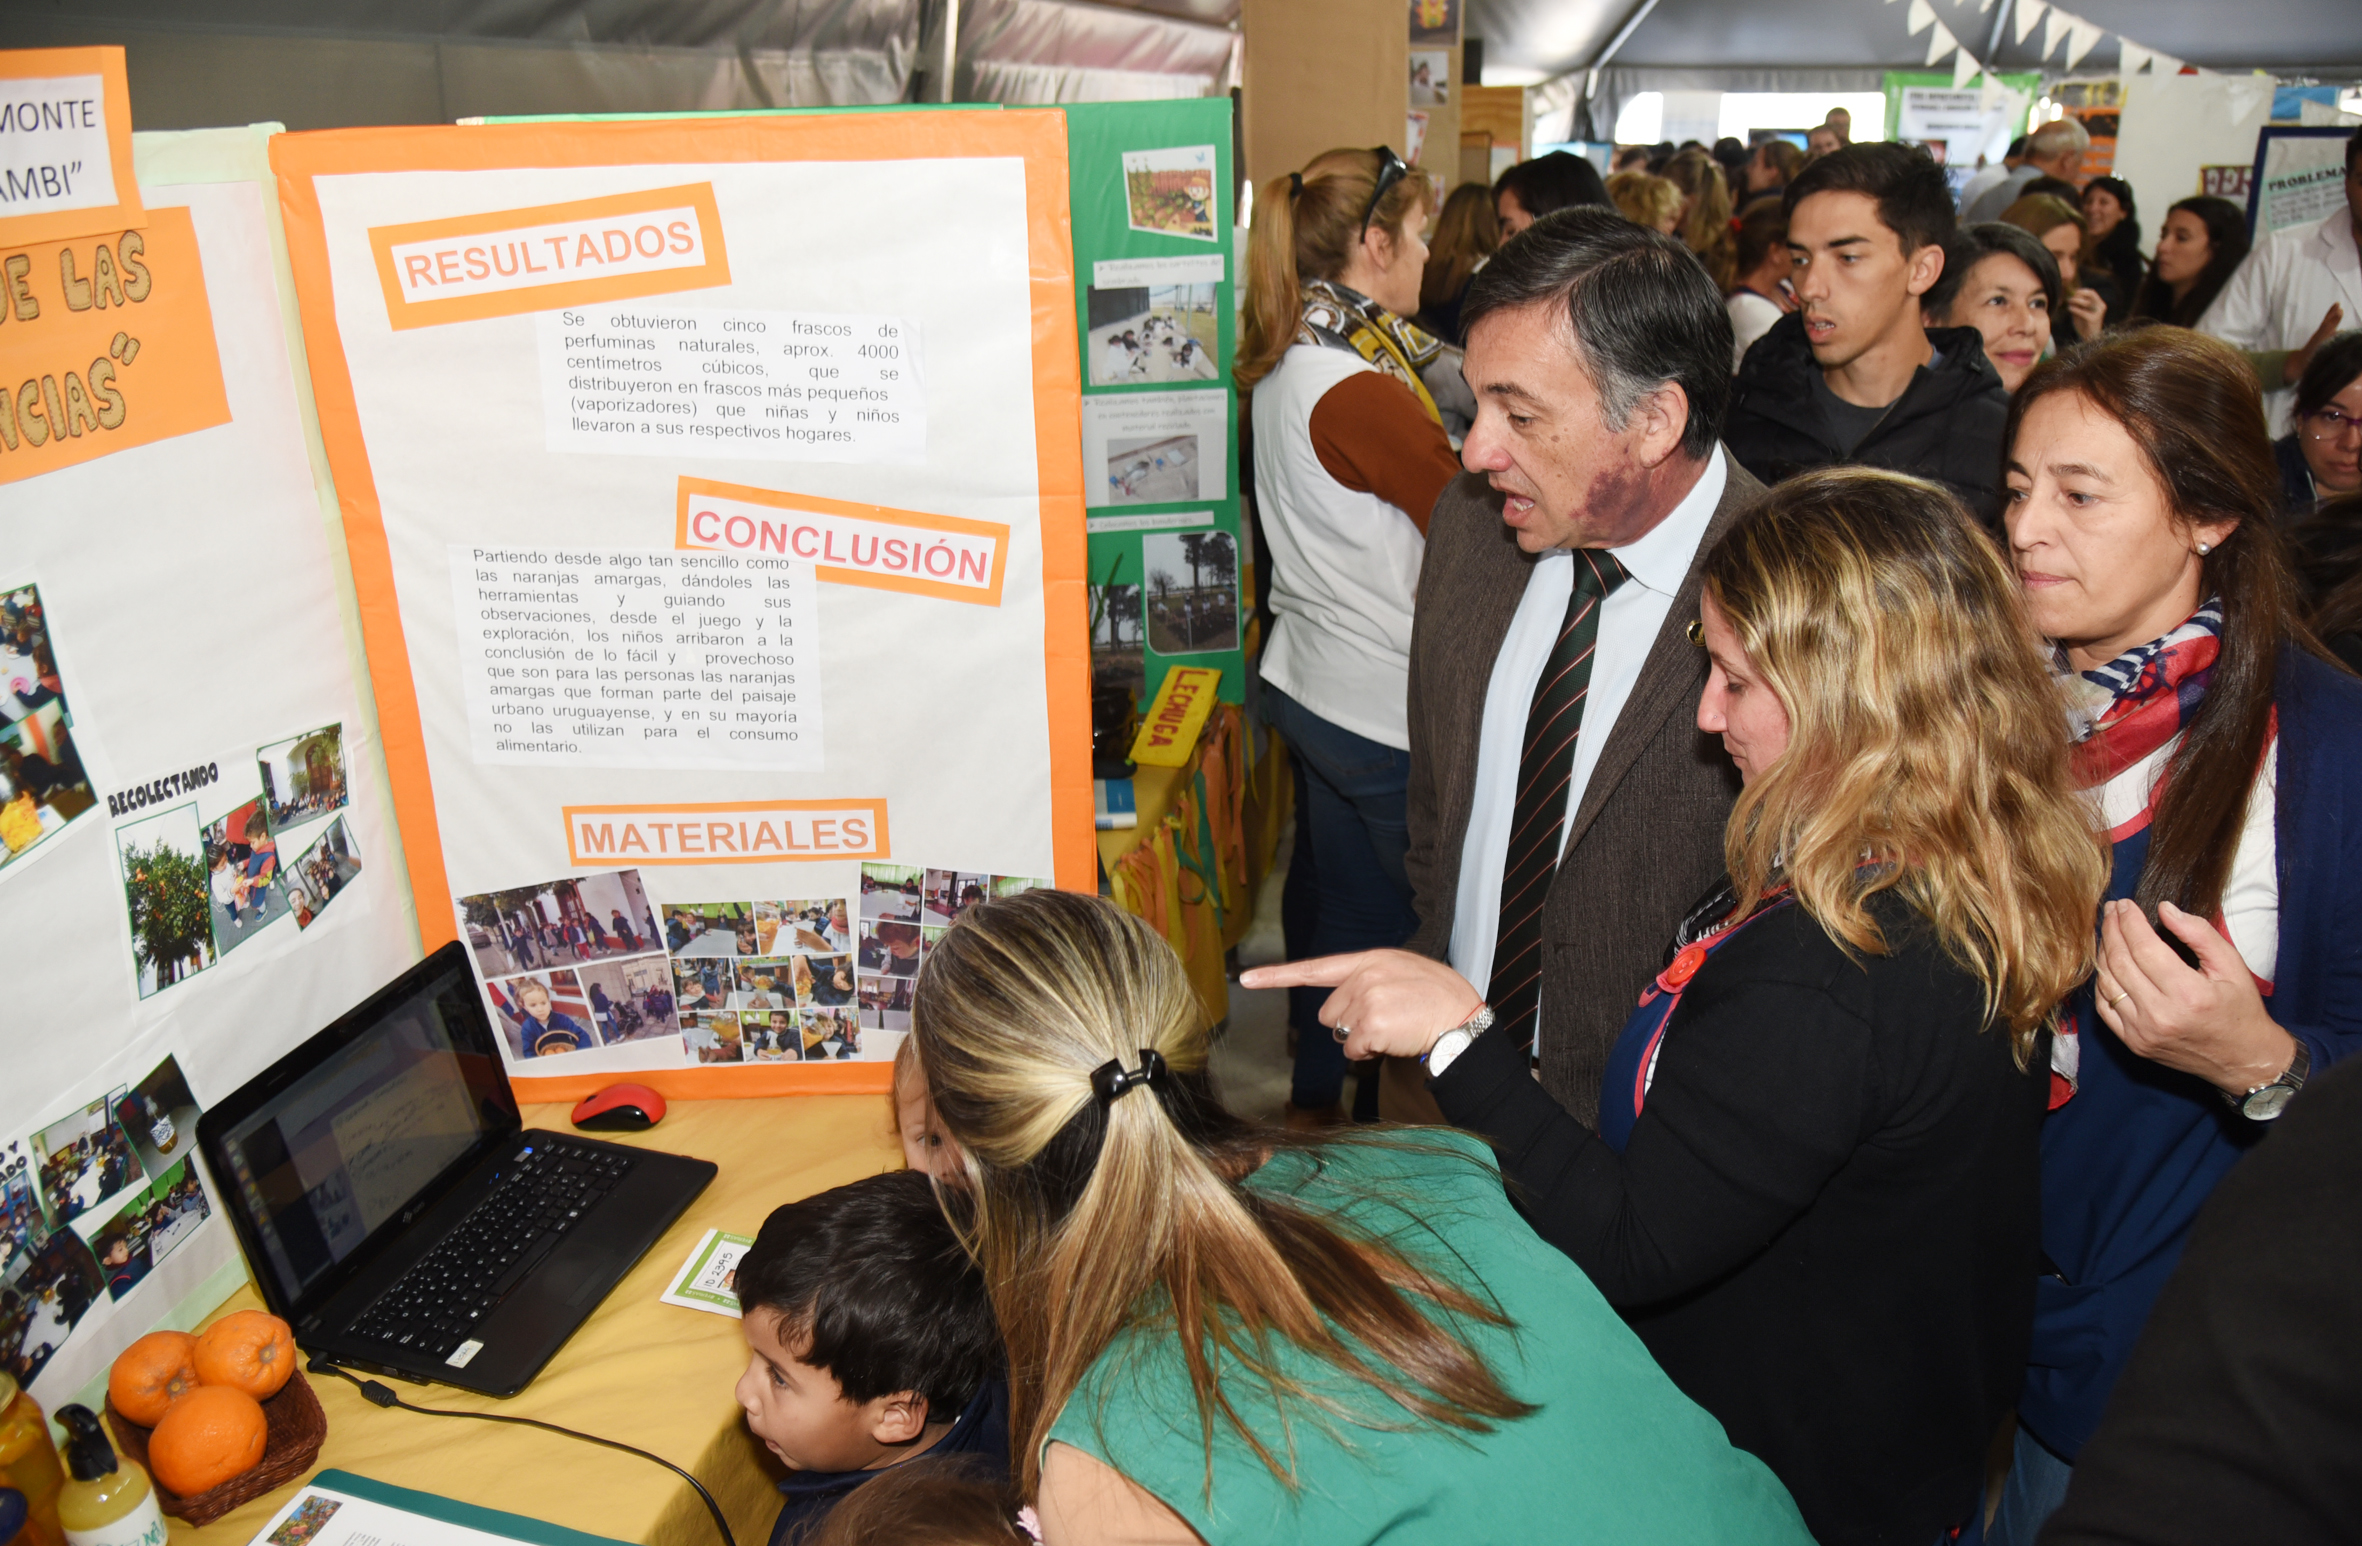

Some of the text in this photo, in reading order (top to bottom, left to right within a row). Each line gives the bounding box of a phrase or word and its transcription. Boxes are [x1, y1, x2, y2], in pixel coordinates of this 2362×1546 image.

[404, 221, 695, 289] RESULTADOS
[0, 230, 152, 325] E LAS
[563, 311, 899, 338] Se obtuvieron cinco frascos de
[565, 334, 899, 360] perfuminas naturales, aprox. 4000
[567, 355, 899, 381] centímetros cúbicos, que se
[568, 376, 889, 403] distribuyeron en frascos más pequeños
[571, 396, 900, 424] (vaporizadores) que niñas y niños
[572, 416, 856, 444] llevaron a sus respectivos hogares.
[473, 549, 789, 570] Partiendo desde algo tan sencillo como
[692, 511, 988, 583] CONCLUSIÓN
[476, 569, 790, 589] las naranjas amargas, dándoles las
[478, 588, 792, 609] herramientas y guiando sus
[481, 607, 793, 631] observaciones, desde el juego y la
[483, 627, 793, 647] exploración, los niños arribaron a la
[485, 646, 795, 667] conclusión de lo fácil y provechoso
[487, 666, 796, 687] que son para las personas las naranjas
[490, 684, 797, 705] amargas que forman parte del paisaje
[492, 702, 797, 726] urbano uruguayense, y en su mayoría
[1147, 670, 1209, 747] LECHUGA
[494, 721, 799, 742] no las utilizan para el consumo
[496, 738, 583, 753] alimentario.
[107, 761, 219, 818] RECOLECTANDO
[580, 818, 869, 853] MATERIALES
[703, 1278, 716, 1288] ID
[711, 1252, 734, 1277] 2395
